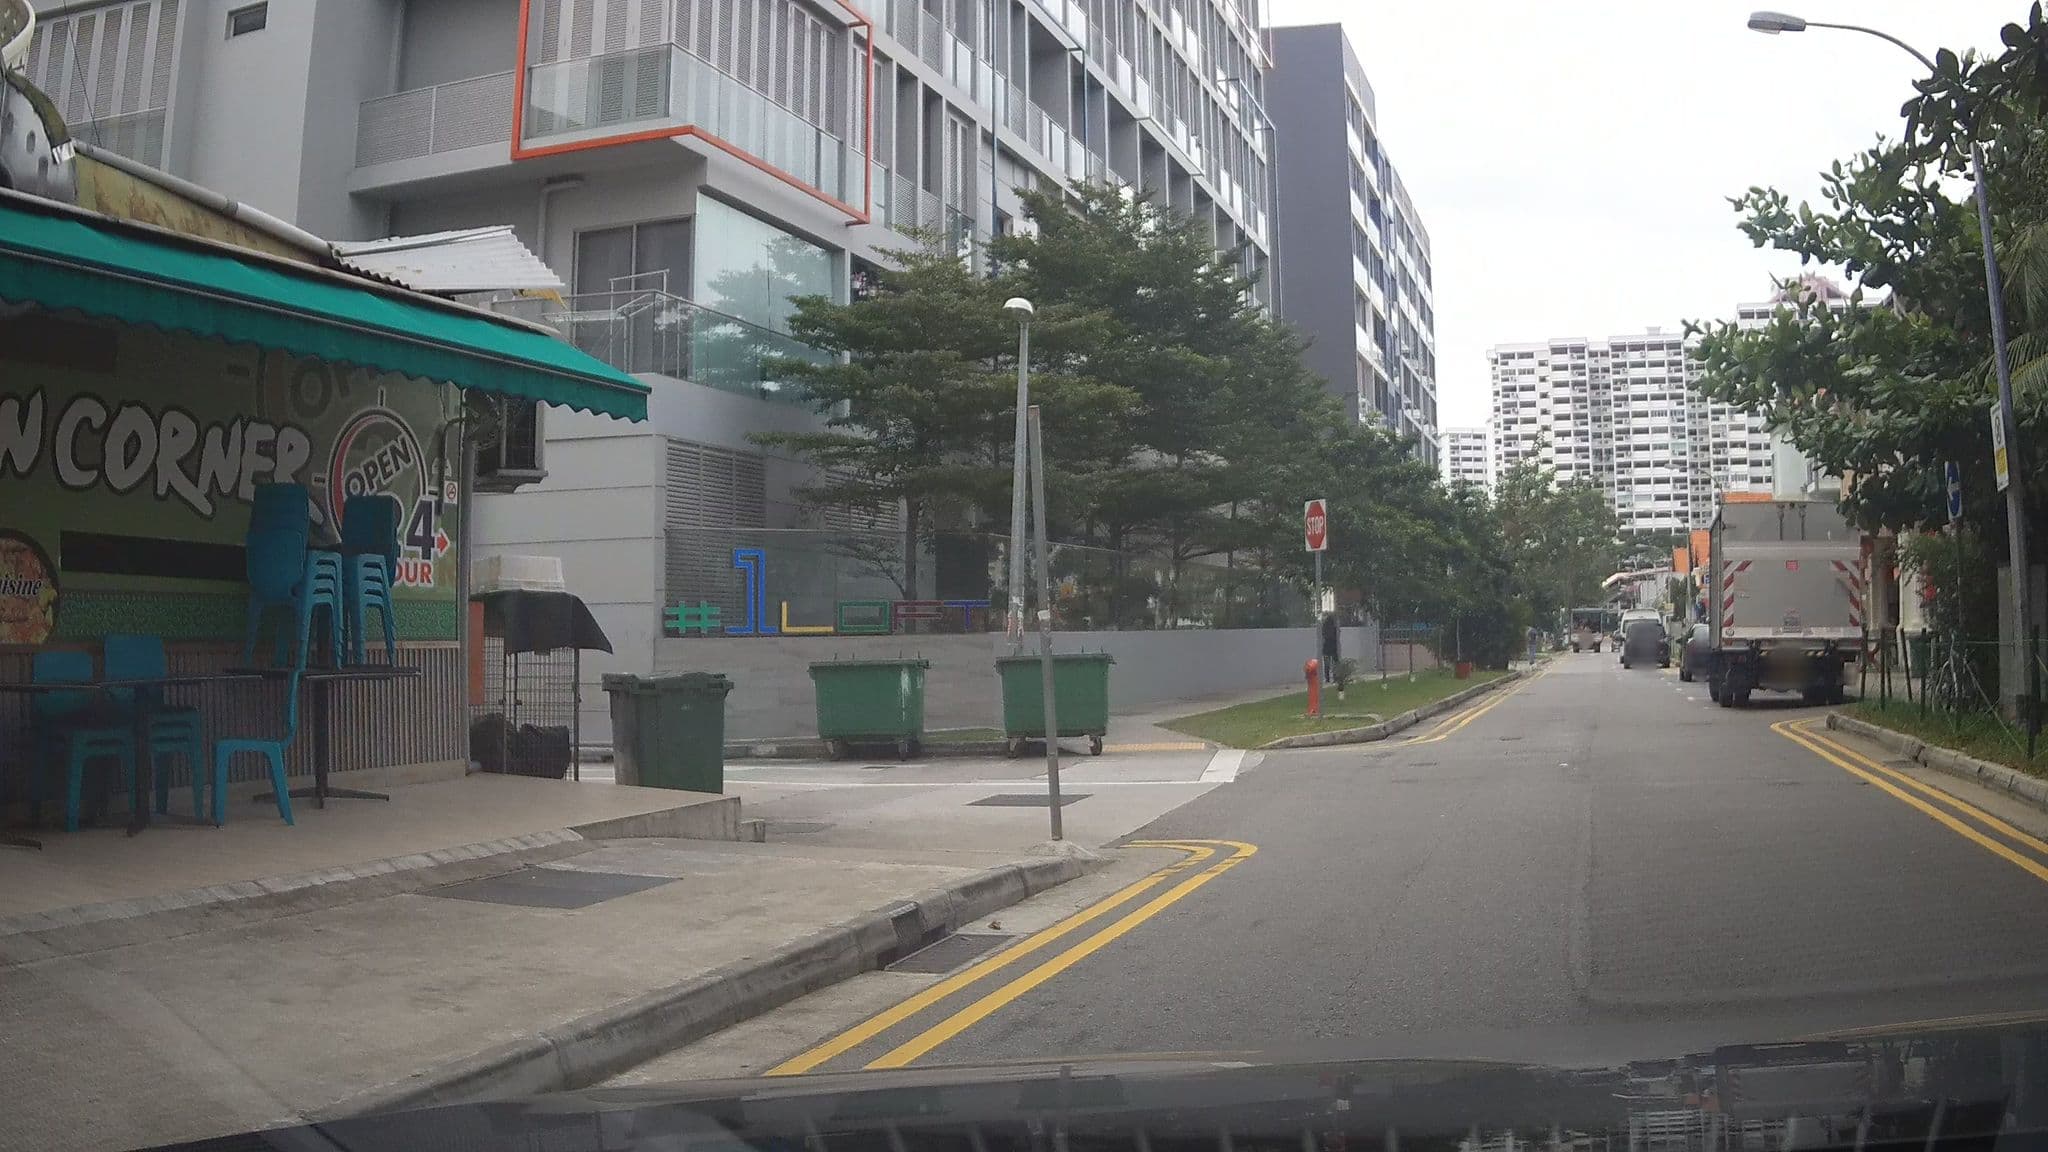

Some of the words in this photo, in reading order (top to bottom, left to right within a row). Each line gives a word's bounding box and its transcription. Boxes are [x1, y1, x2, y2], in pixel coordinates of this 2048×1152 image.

[54, 397, 325, 526] CORNER
[346, 436, 413, 497] OPEN
[1307, 515, 1324, 535] STOP
[0, 573, 42, 596] isine
[394, 560, 433, 585] OUR
